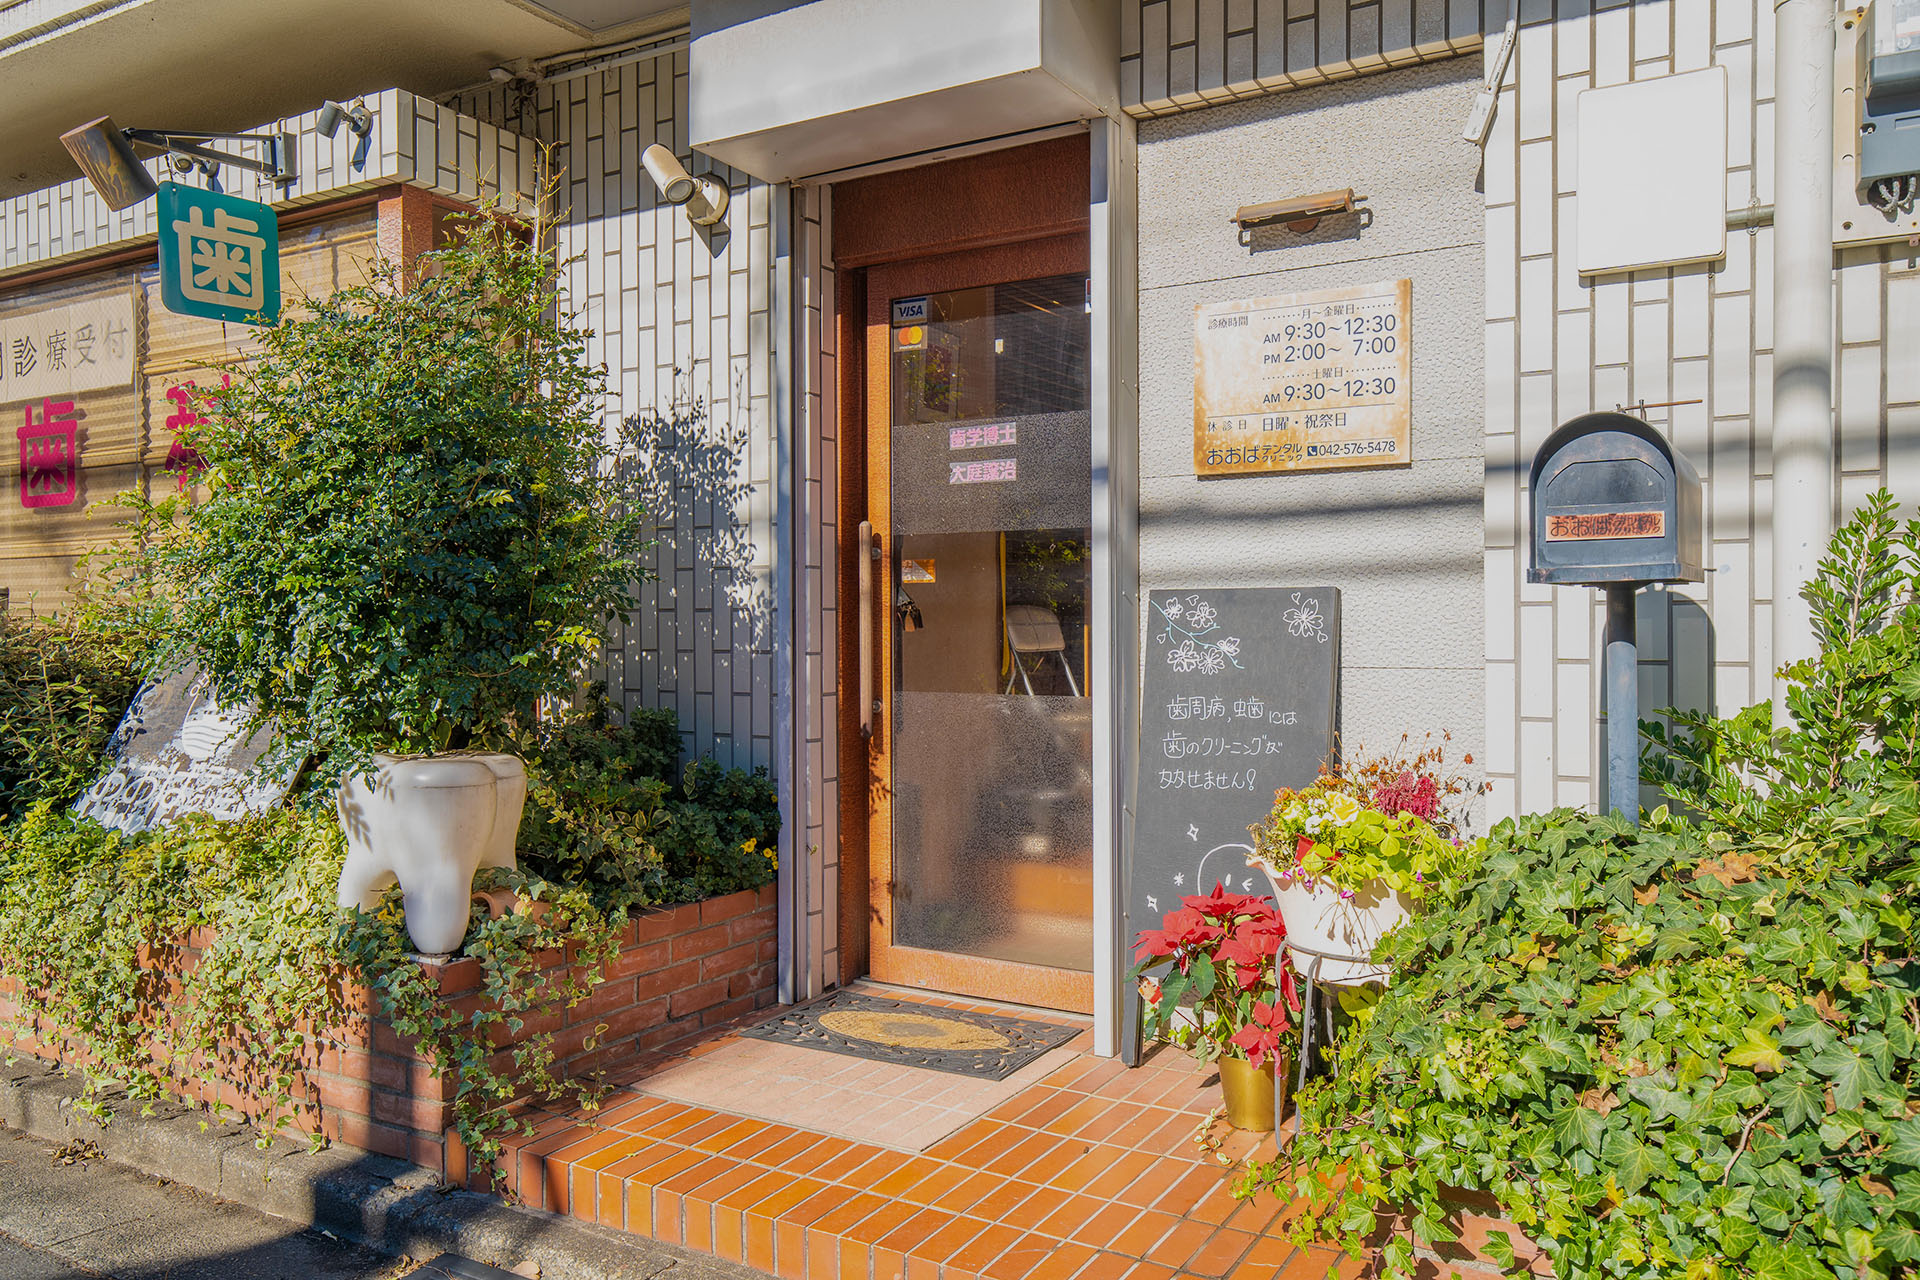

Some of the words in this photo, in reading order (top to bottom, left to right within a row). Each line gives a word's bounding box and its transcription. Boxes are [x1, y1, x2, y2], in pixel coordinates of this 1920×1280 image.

[172, 205, 266, 312] 歯
[898, 305, 924, 317] VISA
[1208, 316, 1249, 330] 診療時間
[1263, 333, 1281, 344] AM
[0, 318, 128, 380] 診療受付
[1263, 354, 1281, 365] PM
[1353, 336, 1396, 356] 7:00
[1312, 367, 1343, 380] 土曜日
[1263, 393, 1281, 404] AM
[16, 397, 78, 508] 歯
[1206, 445, 1262, 466] おおば
[1318, 440, 1396, 457] 042-576-5478
[1262, 453, 1303, 463] クリニック
